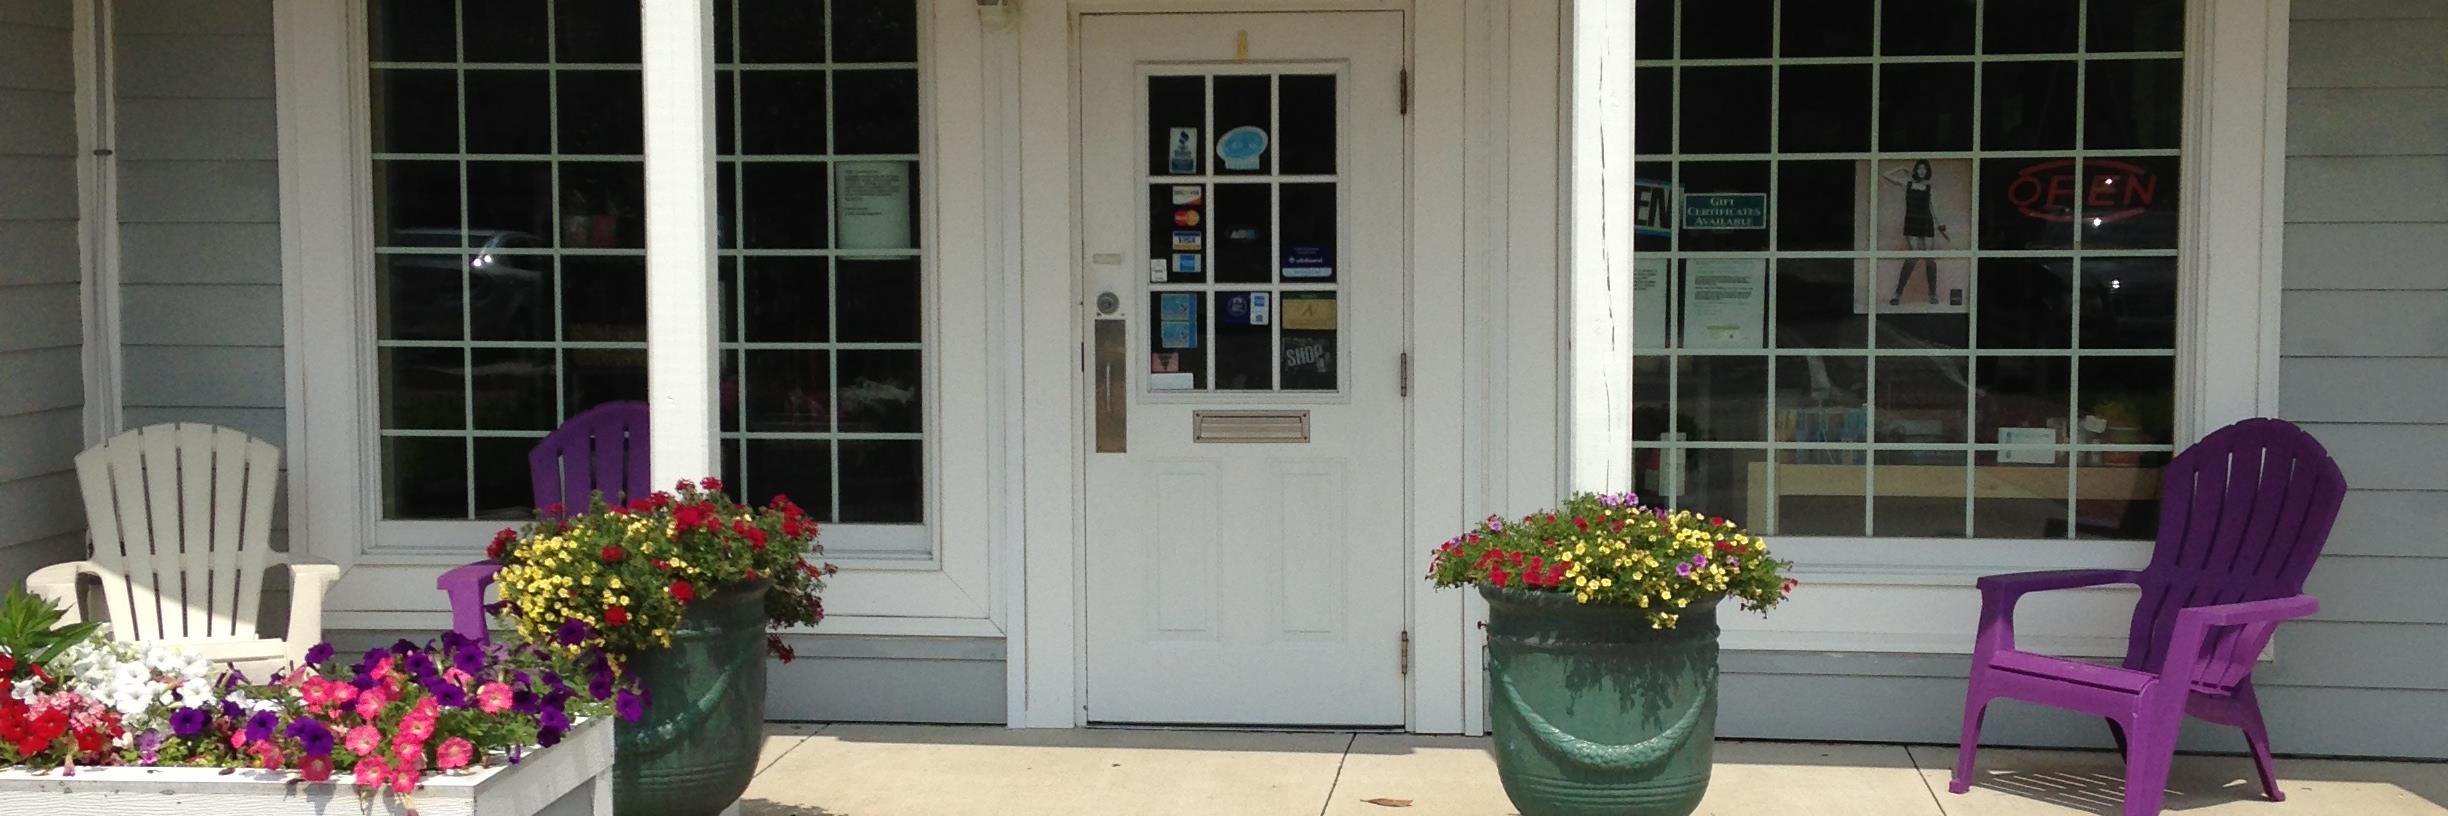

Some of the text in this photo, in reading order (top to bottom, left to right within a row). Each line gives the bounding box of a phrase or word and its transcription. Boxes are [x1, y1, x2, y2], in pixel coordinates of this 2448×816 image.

[2008, 174, 2157, 206] OPEN
[1709, 197, 1735, 206] GIFT
[1687, 206, 1761, 216] CERTIFICATES
[1695, 216, 1752, 225] AVAILABLE
